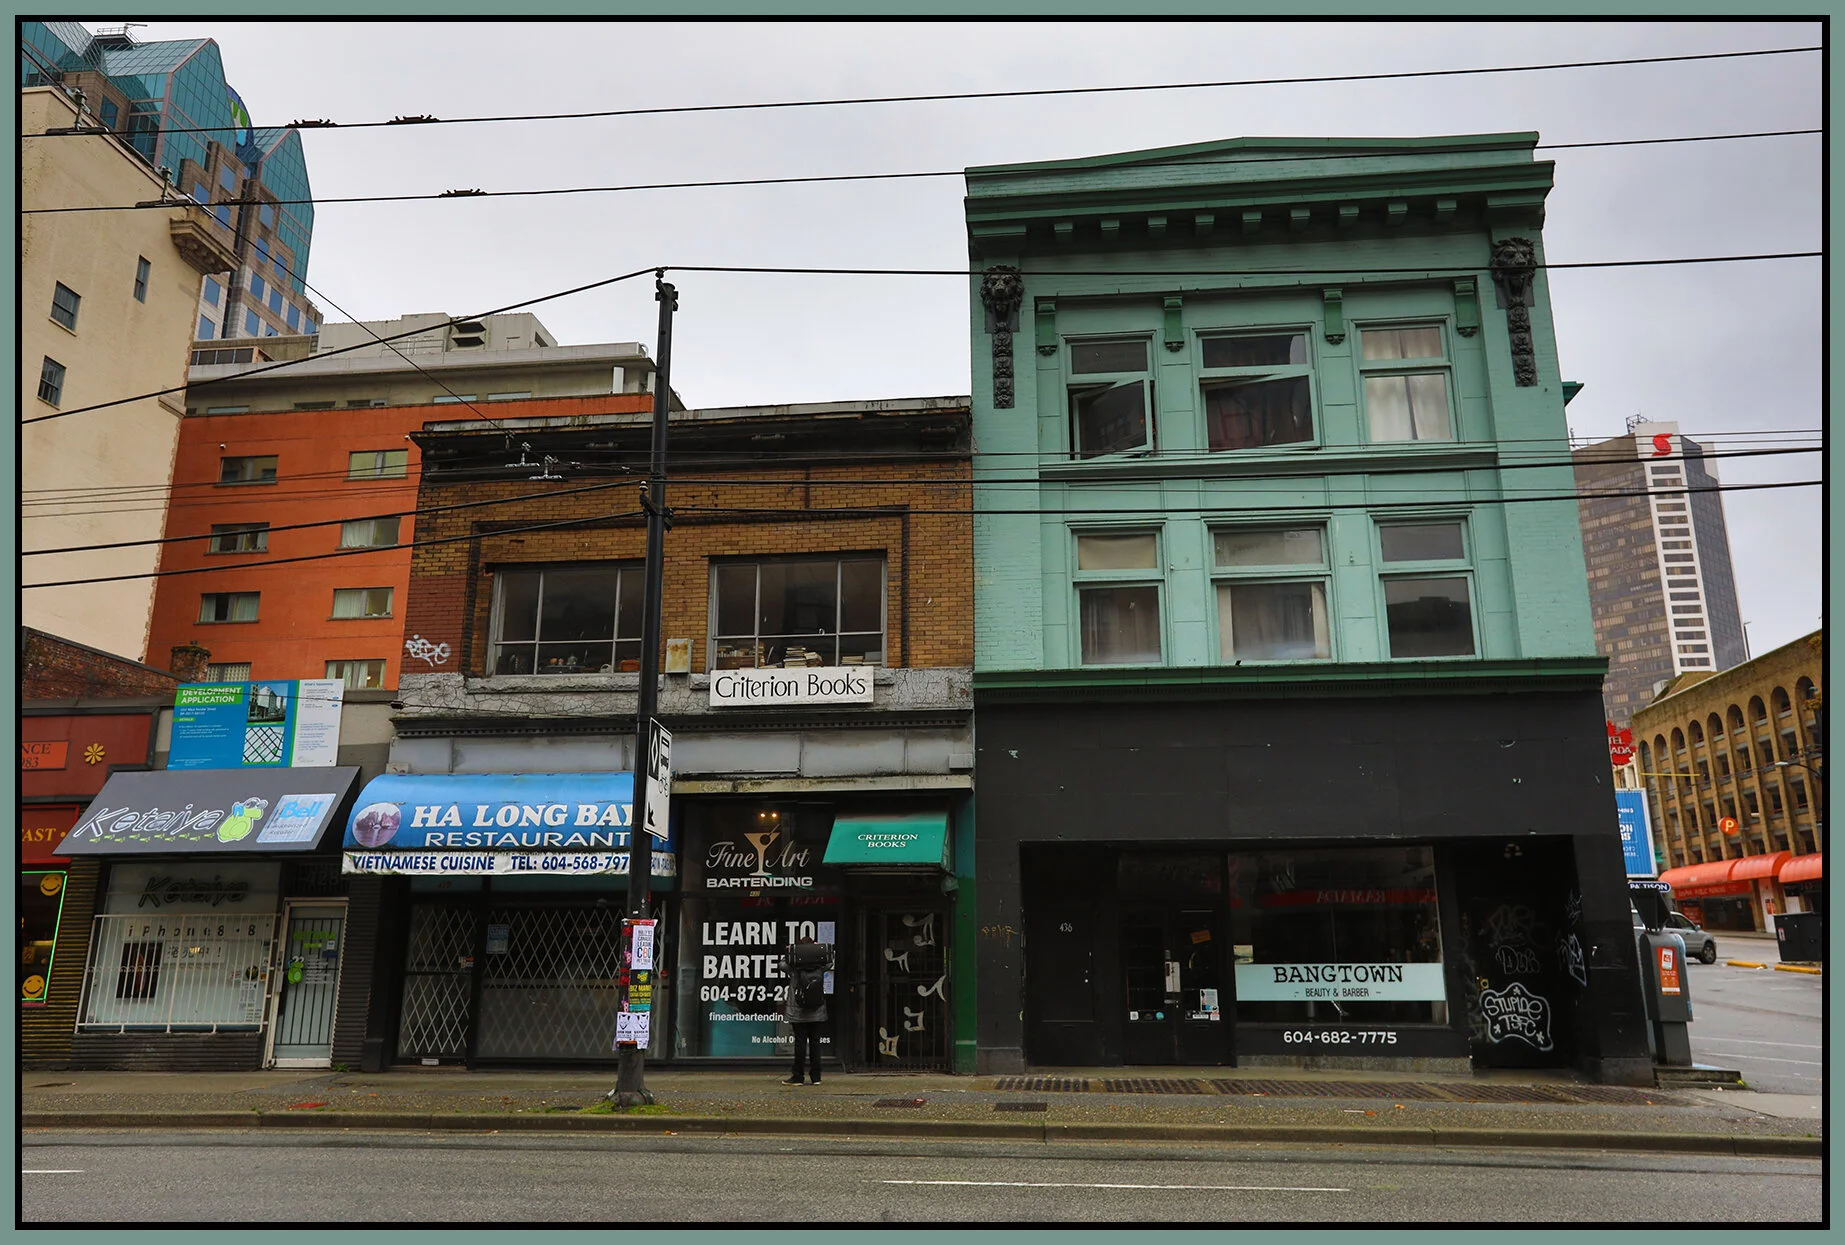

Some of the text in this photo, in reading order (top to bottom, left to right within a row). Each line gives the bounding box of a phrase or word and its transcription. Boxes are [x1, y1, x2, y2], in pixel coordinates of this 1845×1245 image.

[182, 687, 242, 697] DEVELOPMENT
[715, 673, 867, 700] Criterion Books
[180, 695, 235, 704] APPLICATION
[1608, 736, 1624, 745] TEL
[1610, 746, 1632, 755] ADA
[279, 801, 325, 820] Bell
[410, 804, 464, 828] HA
[471, 803, 570, 828] LONG
[73, 803, 224, 837] Ketaiya
[1725, 820, 1735, 832] P
[22, 827, 57, 842] AST
[424, 831, 631, 847] RESTAURANT
[857, 833, 919, 841] CRITERION
[867, 840, 907, 848] BOOKS
[705, 841, 755, 868] Fine
[765, 840, 813, 868] Art
[352, 855, 630, 872] VIETNAMESE CUISINE TEL: 604-568-797
[706, 876, 813, 889] BARTENDING
[1629, 883, 1668, 891] PATISON
[702, 921, 778, 946] LEARN
[785, 920, 817, 945] TO
[1059, 923, 1073, 933] 436
[1272, 965, 1404, 984] BANGTOWN
[700, 985, 790, 1002] 604-873-28
[1305, 987, 1370, 998] BEAUTY & BARBER
[708, 1012, 790, 1024] fineartbartendin
[751, 1036, 761, 1044] No
[762, 1035, 788, 1044] Alcohol
[1283, 1031, 1398, 1045] 604-682-7775
